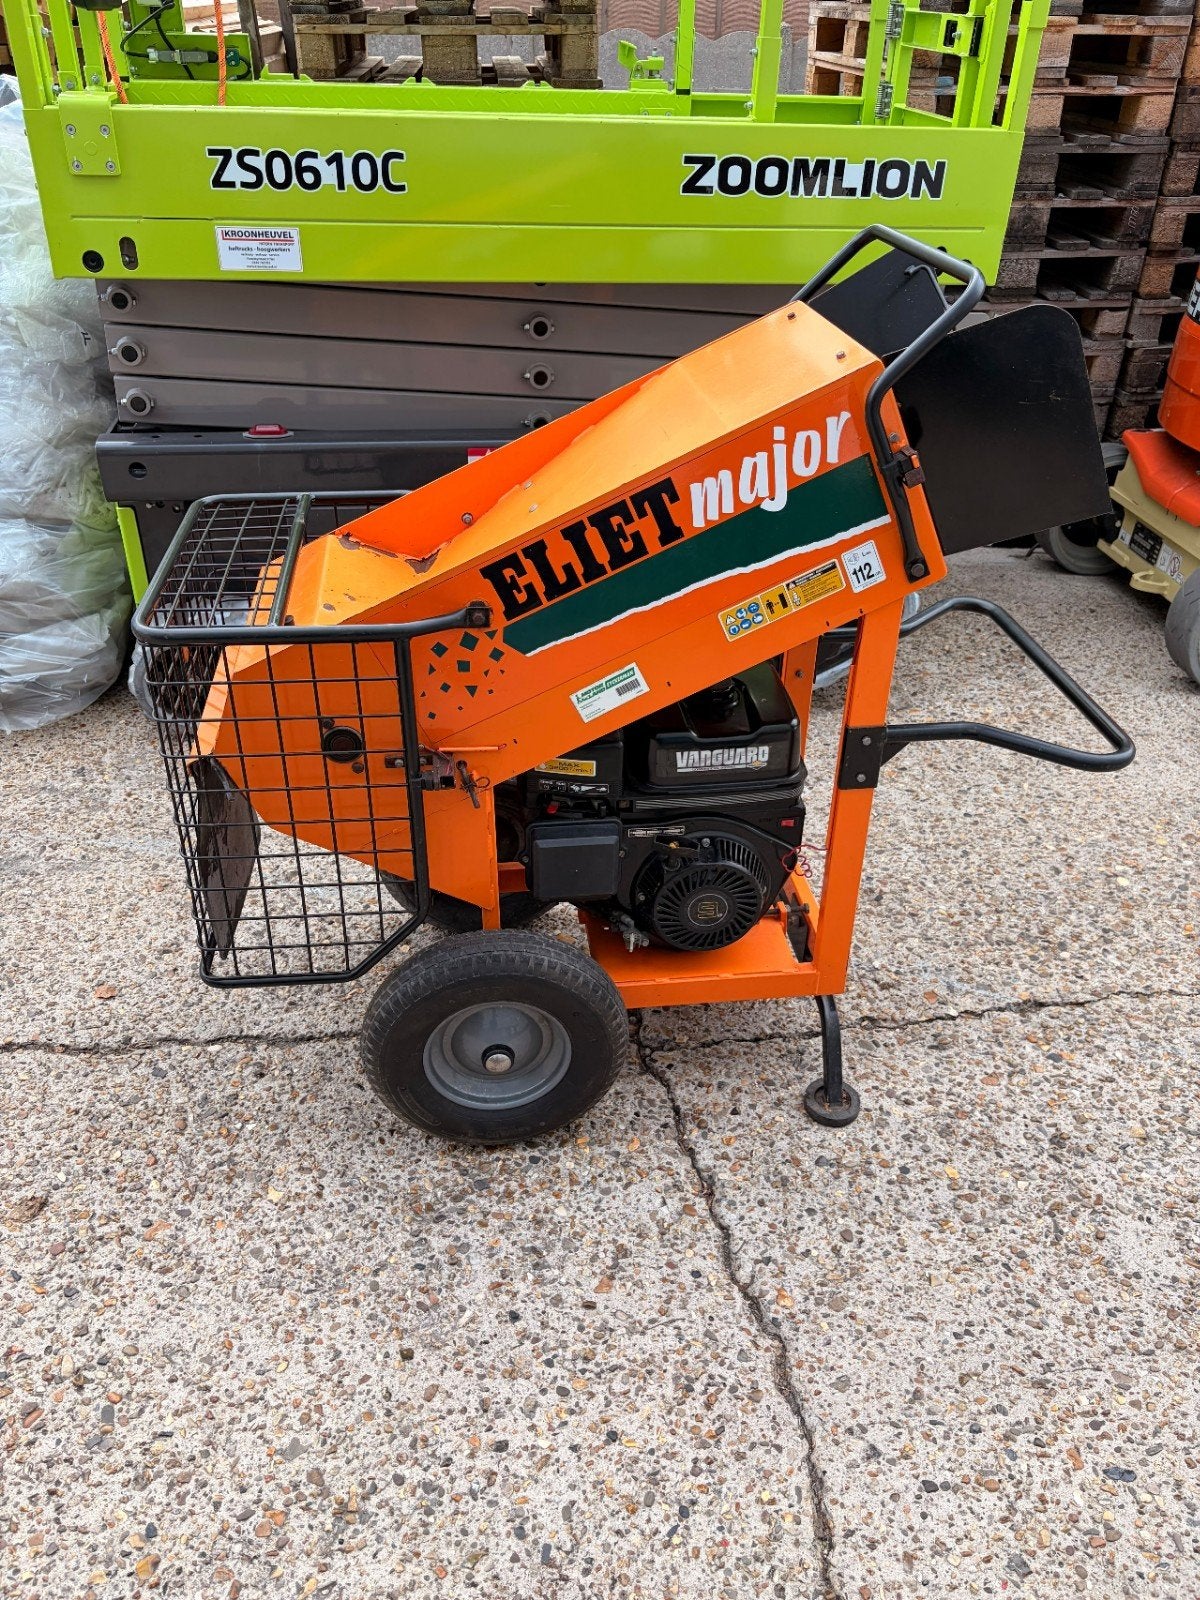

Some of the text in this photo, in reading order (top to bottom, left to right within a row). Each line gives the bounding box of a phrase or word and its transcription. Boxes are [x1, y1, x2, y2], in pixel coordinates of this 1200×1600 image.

[206, 148, 407, 193] ZS0610C
[681, 155, 947, 199] ZOOMLION
[224, 230, 294, 239] KROONHEUVEL
[479, 411, 852, 622] ELIET major
[852, 563, 875, 585] 112
[676, 746, 769, 768] VANGUARD
